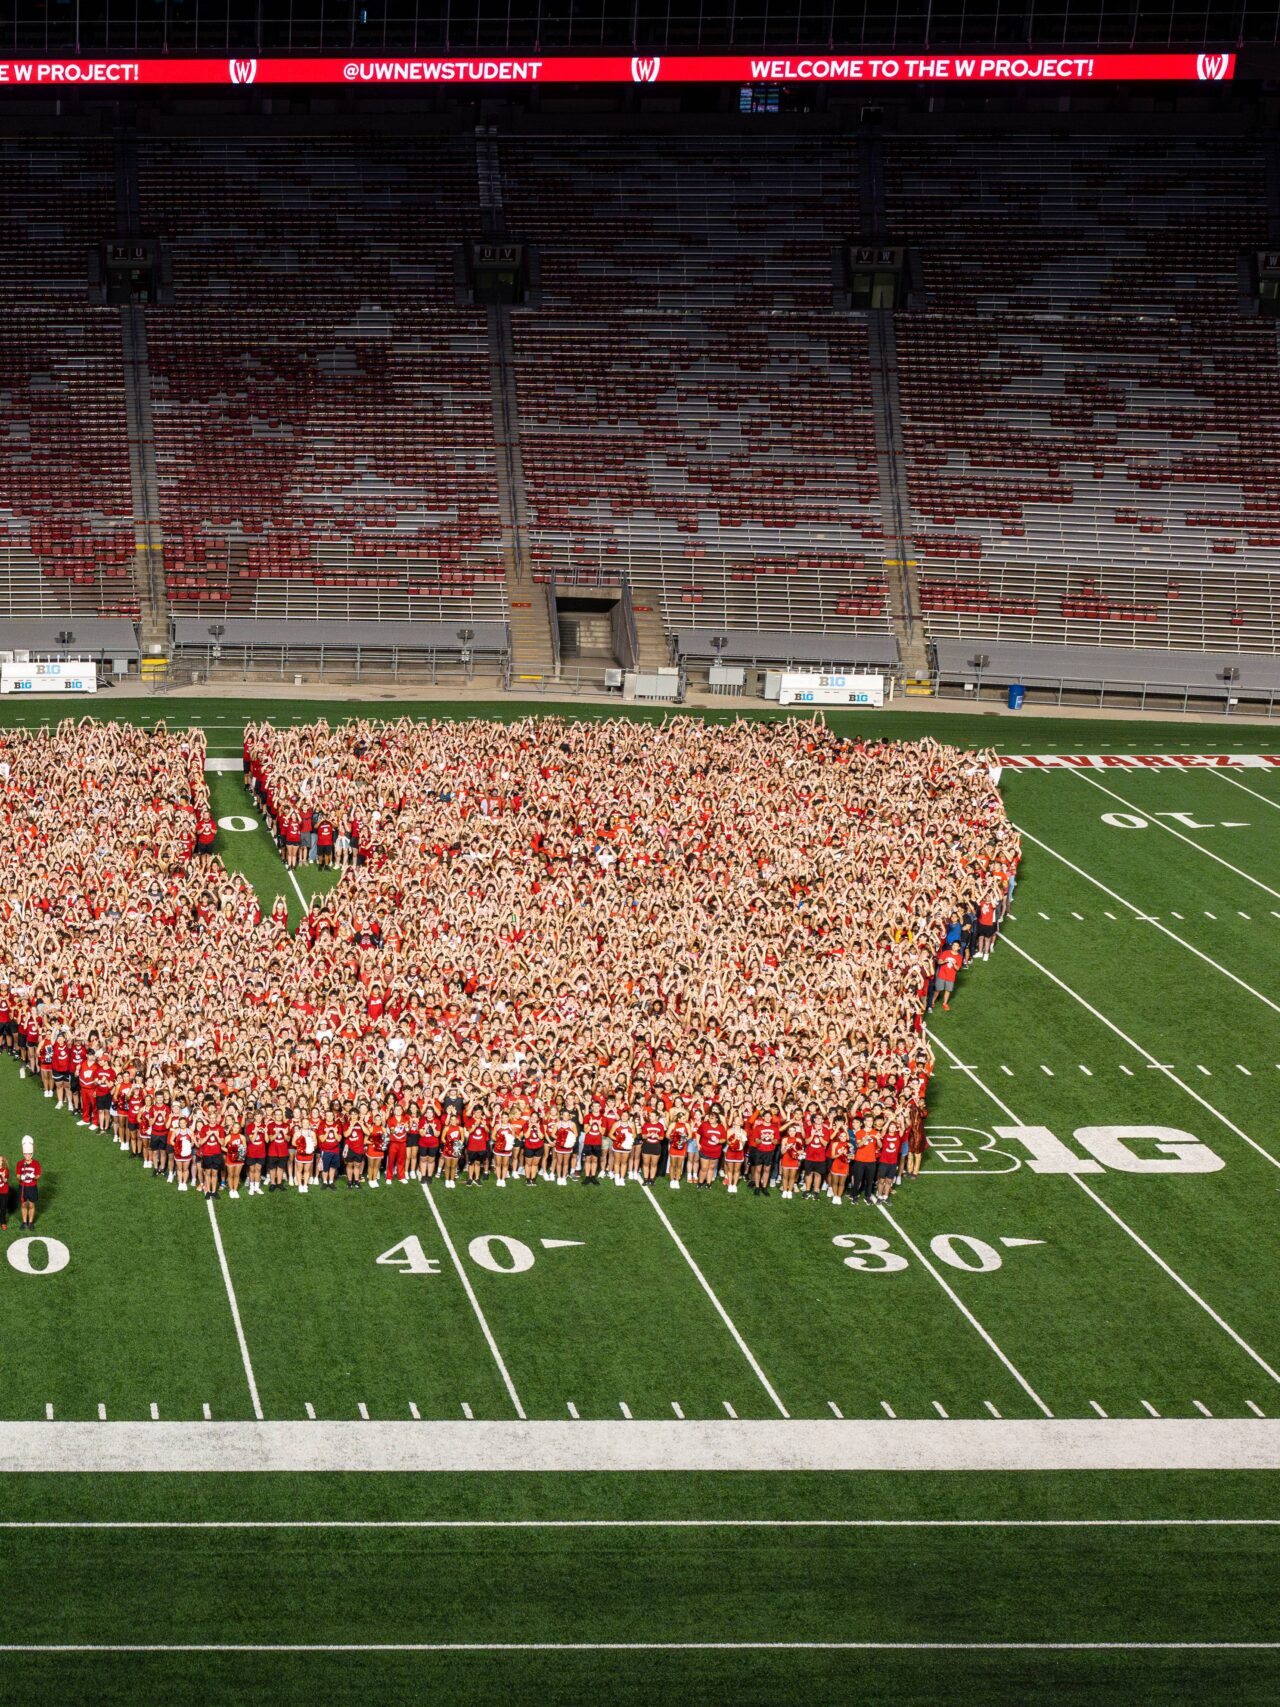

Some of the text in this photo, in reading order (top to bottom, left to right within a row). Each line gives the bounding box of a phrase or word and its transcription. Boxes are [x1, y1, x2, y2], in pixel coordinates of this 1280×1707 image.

[13, 65, 33, 82] W
[37, 64, 139, 81] PROJECT!
[343, 62, 543, 80] @UWNEWSTUDENT
[750, 59, 1094, 78] WELCOME TO THE W PROJECT!
[999, 756, 1244, 767] ALVAREZ
